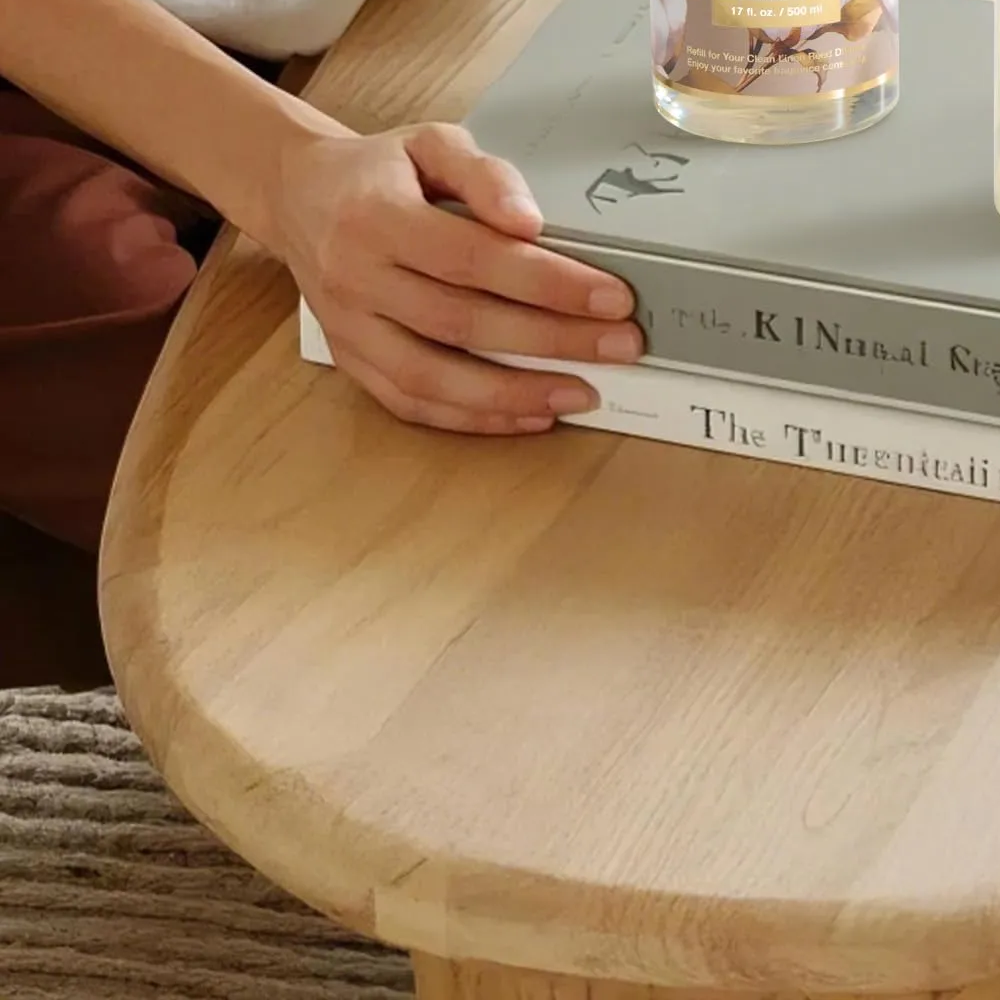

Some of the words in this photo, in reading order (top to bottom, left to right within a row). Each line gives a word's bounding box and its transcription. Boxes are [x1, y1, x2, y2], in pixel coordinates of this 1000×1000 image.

[731, 6, 744, 16] 17
[746, 7, 757, 17] fl.
[759, 9, 776, 17] oz.
[787, 5, 807, 16] 500
[686, 45, 706, 57] Refill
[708, 49, 720, 60] for
[722, 52, 745, 62] Your
[747, 54, 776, 63] Clean
[687, 58, 709, 72] Enjoy
[711, 65, 732, 73] your
[734, 64, 769, 75] favorite
[690, 404, 766, 447] The
